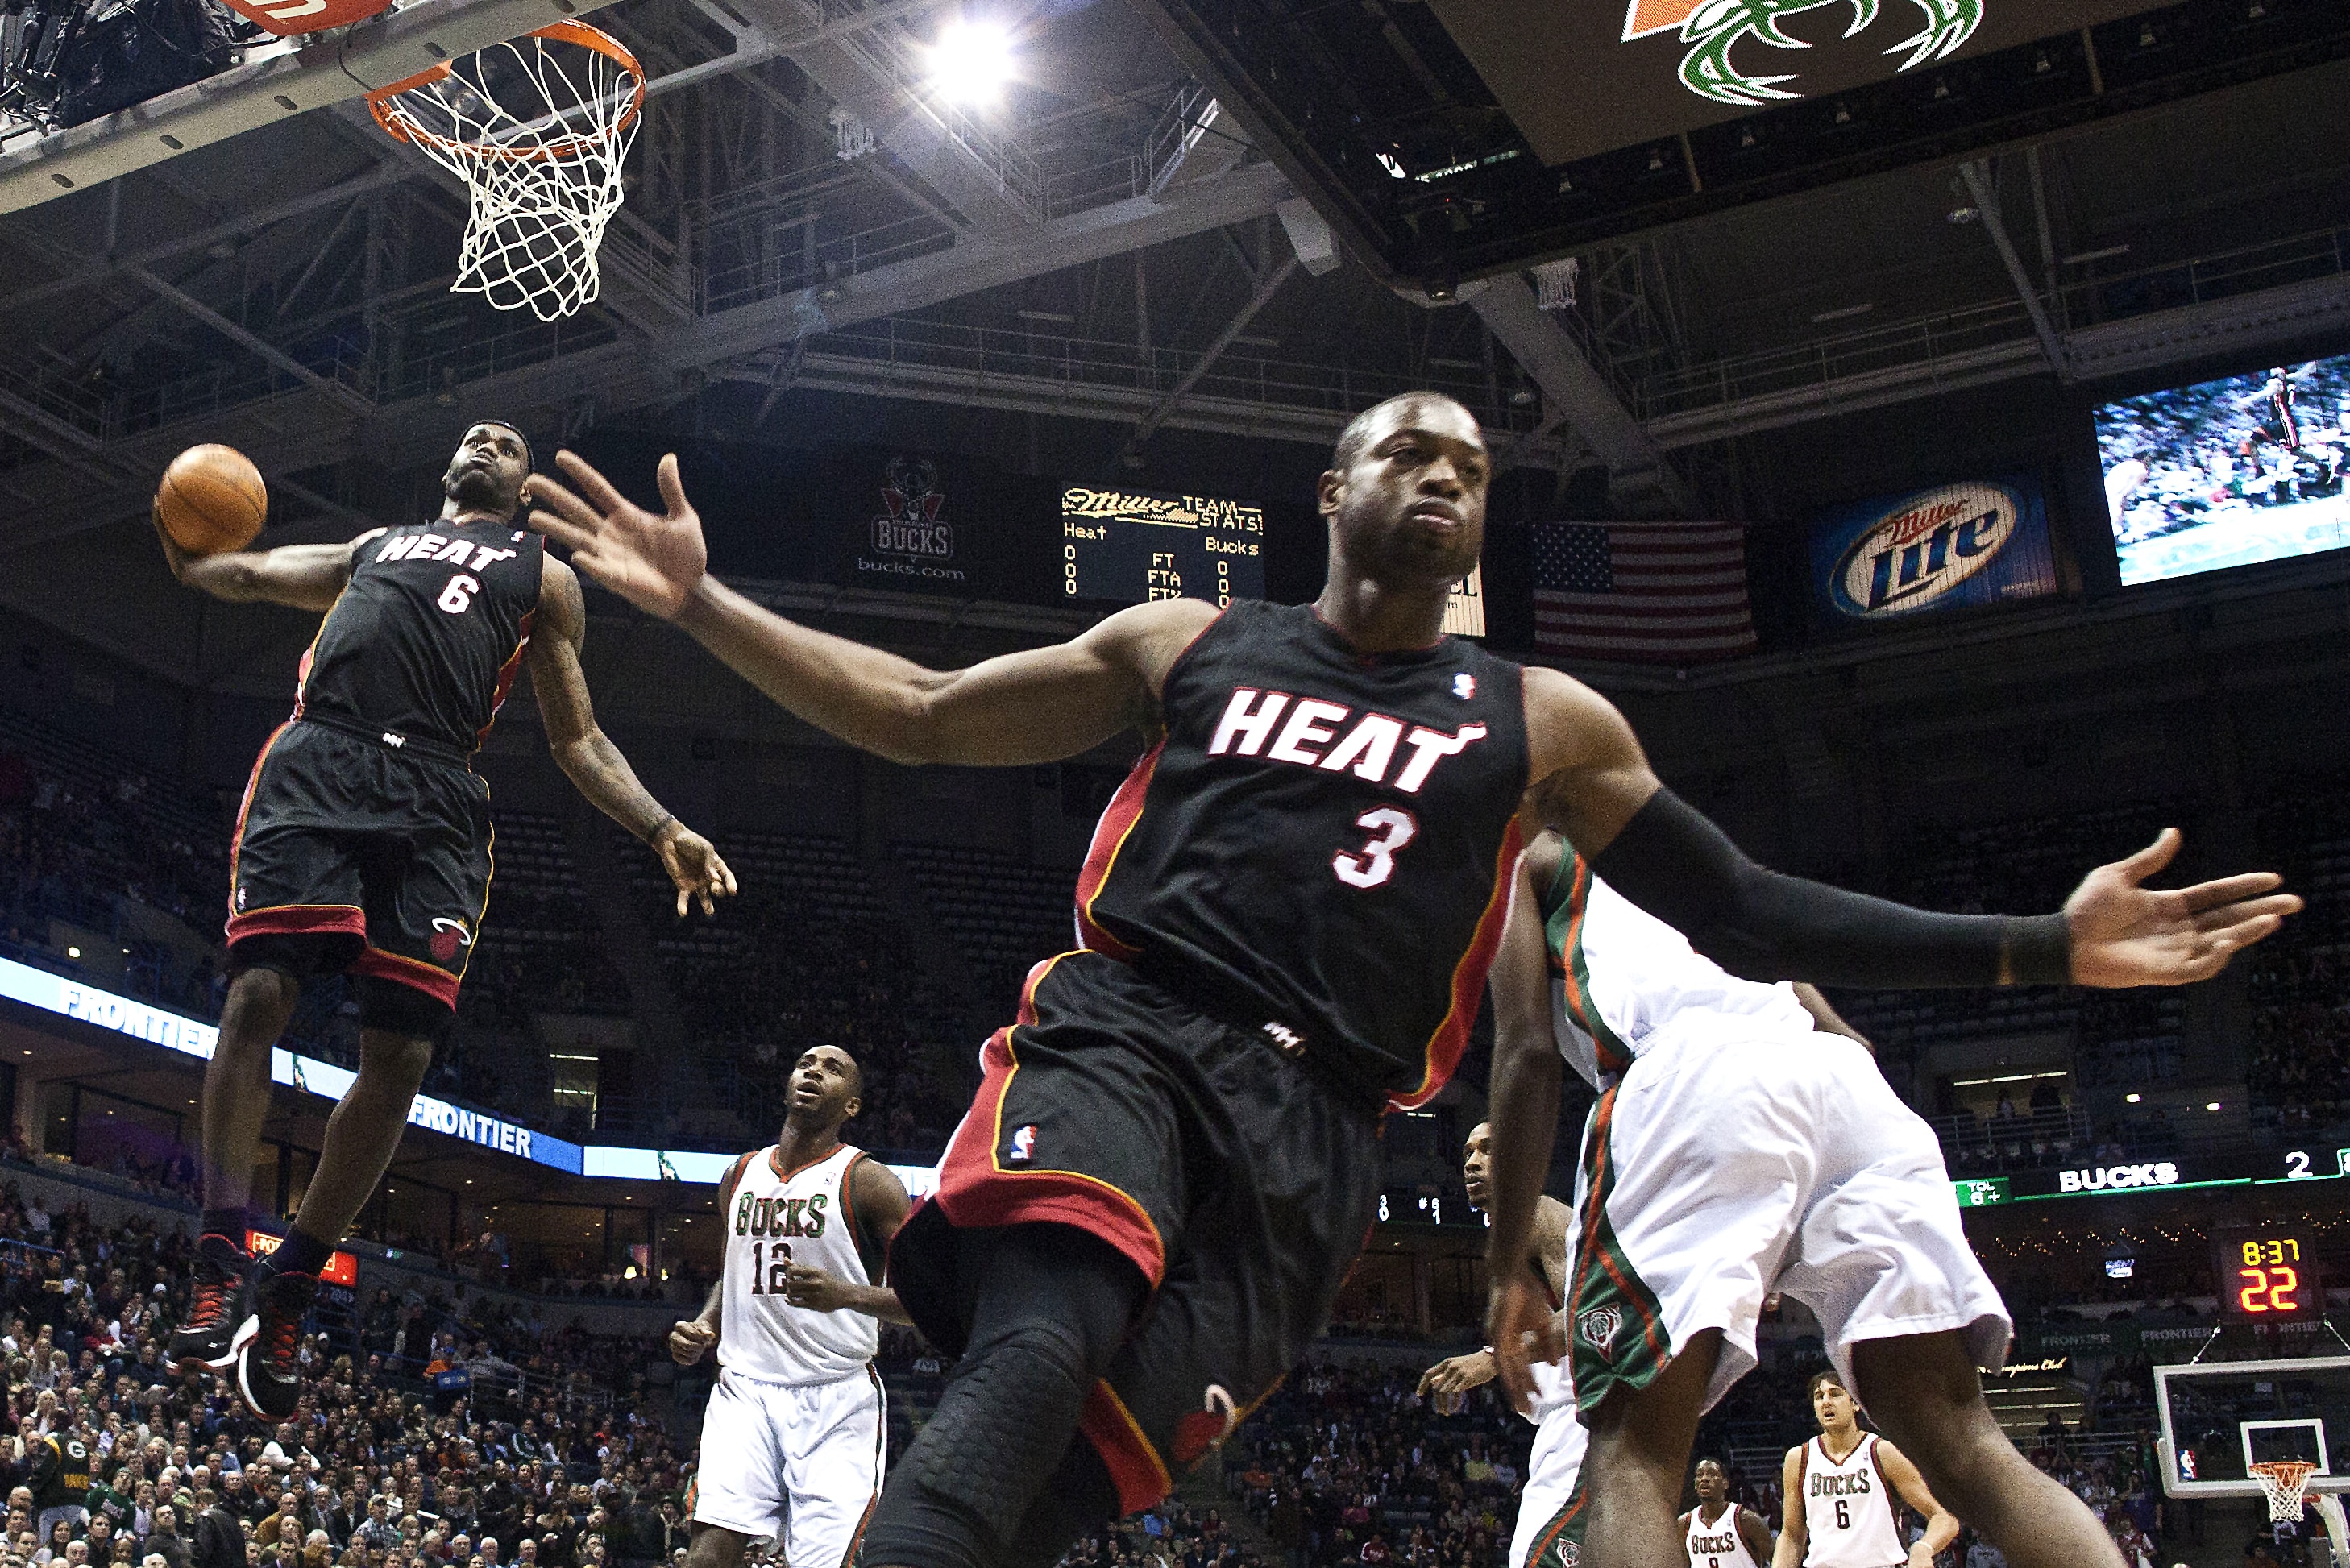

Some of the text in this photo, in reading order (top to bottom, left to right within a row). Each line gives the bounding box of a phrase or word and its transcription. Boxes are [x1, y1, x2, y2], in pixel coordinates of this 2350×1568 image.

[1065, 487, 1179, 512] Miller
[1182, 496, 1238, 516] TEAM
[878, 521, 949, 555] BUCKS
[1200, 512, 1264, 536] STATS!
[1881, 500, 1968, 545] Miller
[375, 533, 517, 572] HEAT
[1064, 522, 1259, 556] Heat Bucks
[858, 558, 965, 580] bucks.com
[1065, 545, 1228, 575] 0 FT 0
[1865, 508, 1998, 613] Lite
[1065, 562, 1229, 593] 0 FTA 0
[438, 573, 482, 614] 6
[1065, 579, 1077, 595] 0
[1219, 595, 1230, 609] 0
[1207, 686, 1488, 794] HEAT
[1331, 803, 1421, 890] 3
[60, 980, 218, 1060] FRONTIER
[408, 1093, 532, 1159] FRONTIER
[2059, 1162, 2179, 1193] BUCKS
[2286, 1151, 2314, 1178] 2
[736, 1191, 828, 1238] BUCKS
[1379, 1205, 1389, 1222] 0
[1432, 1209, 1440, 1225] 1
[2242, 1239, 2300, 1266] 8:37
[752, 1242, 791, 1295] 12
[2239, 1267, 2298, 1312] 22
[67, 1440, 86, 1459] G
[1810, 1468, 1870, 1497] BUCKS
[1835, 1500, 1850, 1529] 6
[1692, 1531, 1735, 1554] BUCKS
